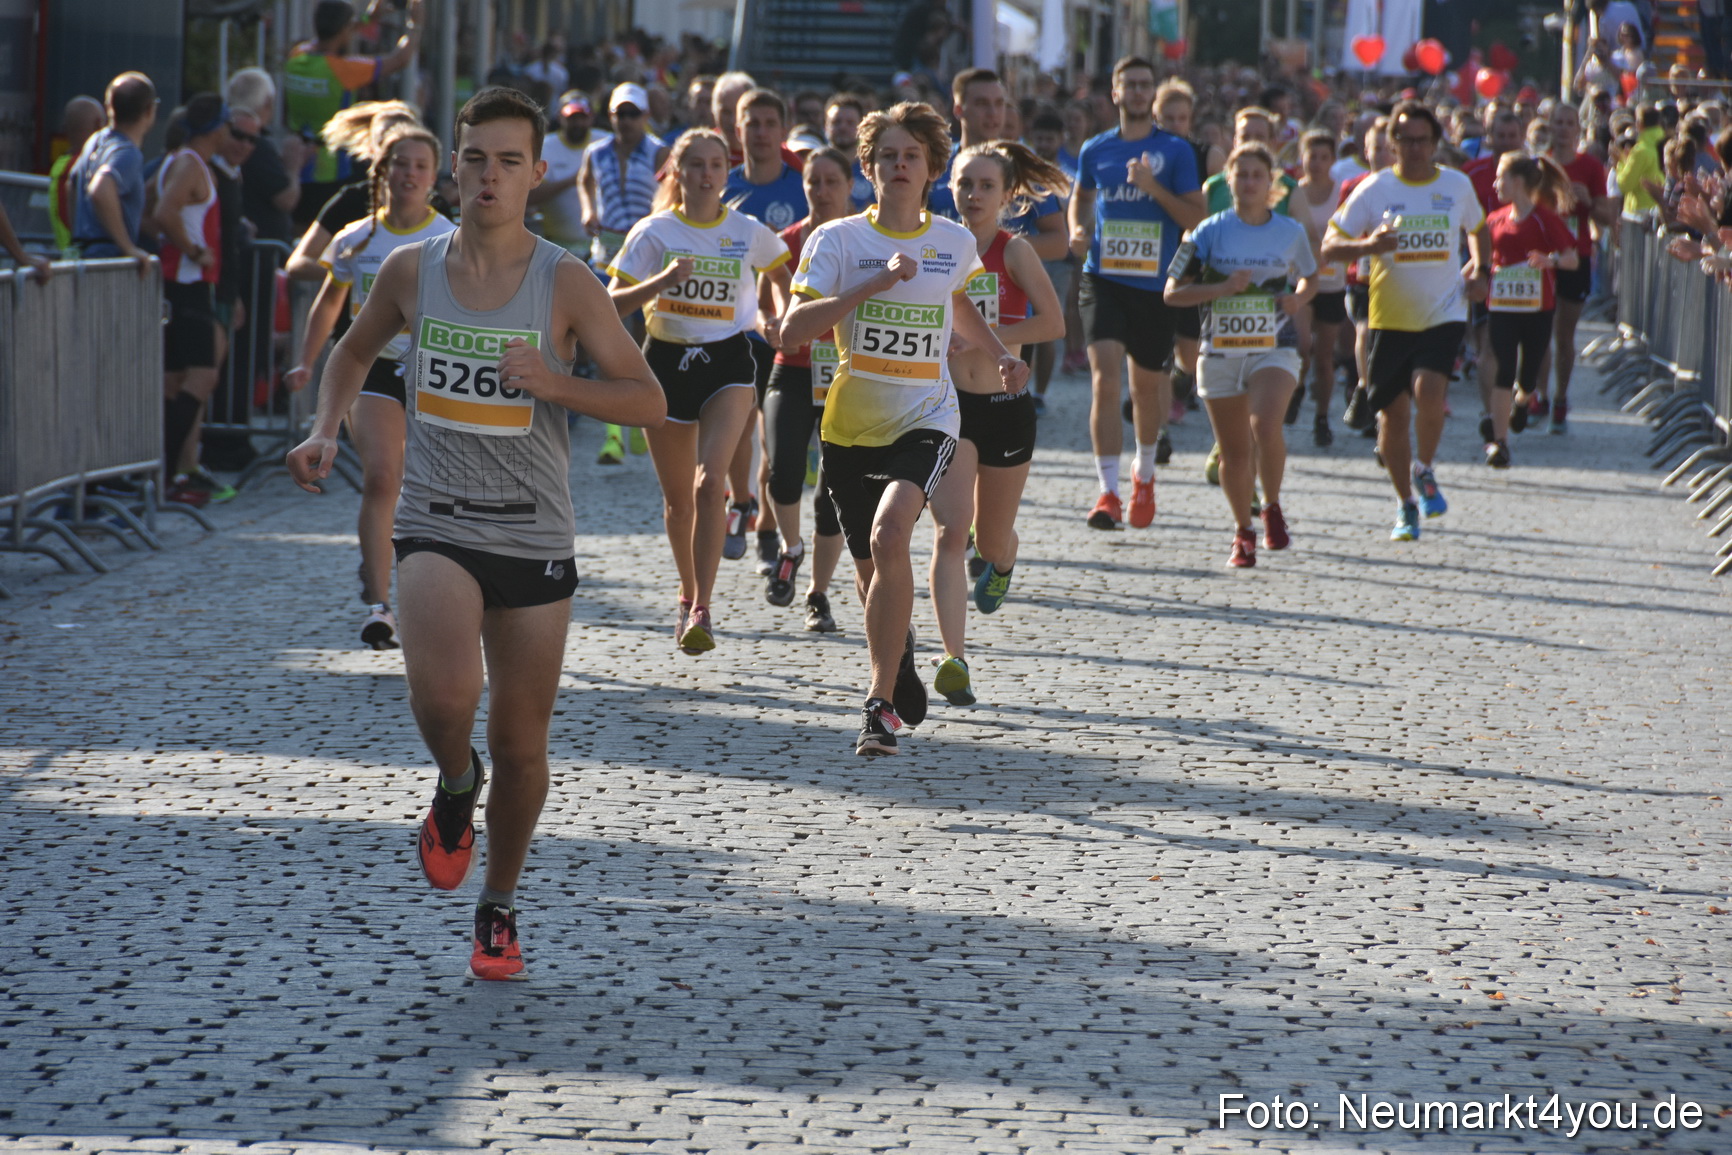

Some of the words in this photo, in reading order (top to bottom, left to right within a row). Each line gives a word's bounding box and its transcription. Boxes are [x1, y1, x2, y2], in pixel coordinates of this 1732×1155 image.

[1106, 240, 1153, 257] 5078
[1398, 232, 1445, 250] 5060
[922, 248, 937, 259] 20
[922, 260, 957, 268] Neumarkter
[1496, 283, 1535, 297] 5183
[669, 303, 722, 318] LUCIANA
[1216, 299, 1266, 312] BOCK
[862, 301, 939, 326] BOCK
[1218, 316, 1268, 333] 5002
[862, 327, 932, 357] 5251
[990, 393, 1015, 403] NIKE
